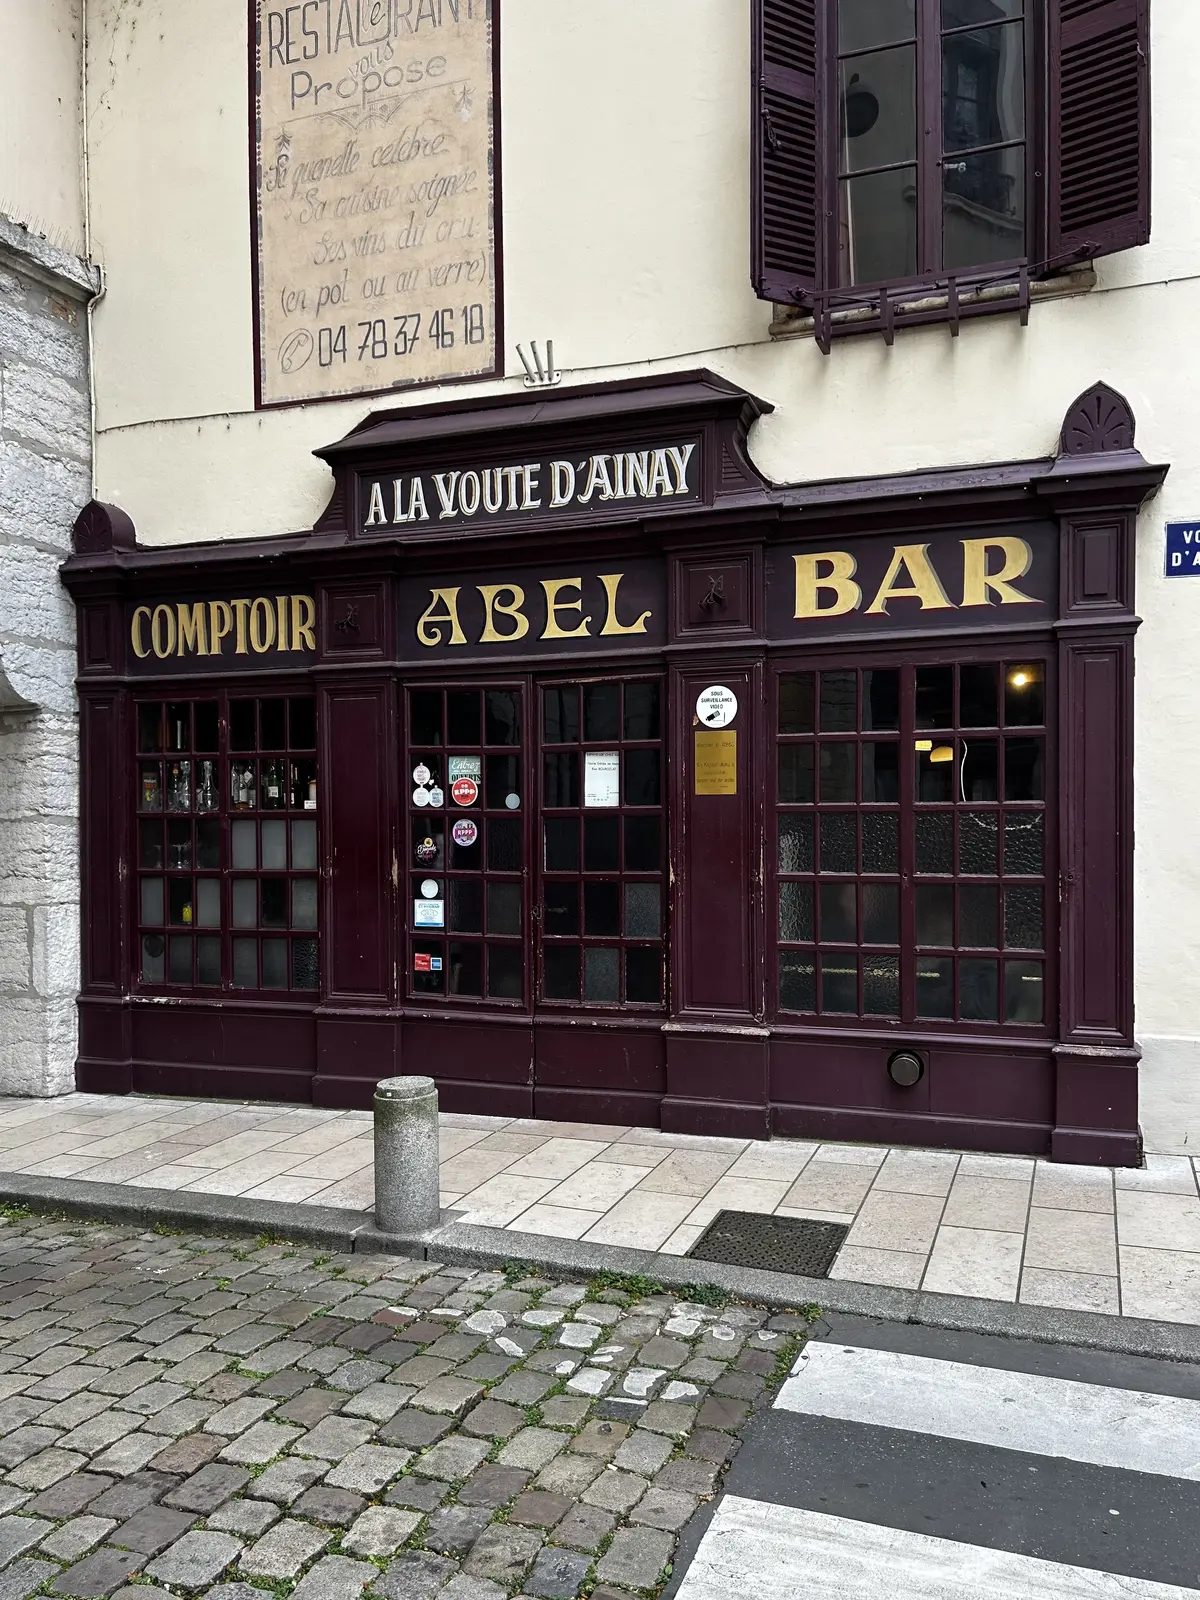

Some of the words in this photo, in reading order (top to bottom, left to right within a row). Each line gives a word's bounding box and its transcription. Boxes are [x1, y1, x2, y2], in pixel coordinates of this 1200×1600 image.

[290, 55, 447, 110] Propose
[347, 40, 395, 79] vous
[290, 138, 360, 201] quenelle
[299, 187, 327, 225] Sa
[335, 180, 398, 218] cuisine
[407, 167, 478, 218] soignée
[313, 230, 347, 266] Ses
[353, 229, 386, 258] vins
[397, 210, 427, 250] du
[280, 285, 307, 318] (en
[315, 267, 349, 319] pot
[362, 274, 386, 299] ou
[395, 267, 419, 295] au
[428, 249, 487, 288] verre)
[318, 324, 347, 367] 04
[357, 318, 388, 361] 78
[393, 312, 421, 356] 37
[428, 307, 455, 350] 46
[461, 303, 486, 345] 18
[364, 482, 388, 526] A
[392, 476, 430, 524] LA
[431, 463, 542, 520] VOUTE
[548, 443, 697, 509] D'AINAY
[791, 536, 1045, 619] BAR
[130, 594, 317, 659] COMPTOIR
[416, 573, 653, 647] ABEL
